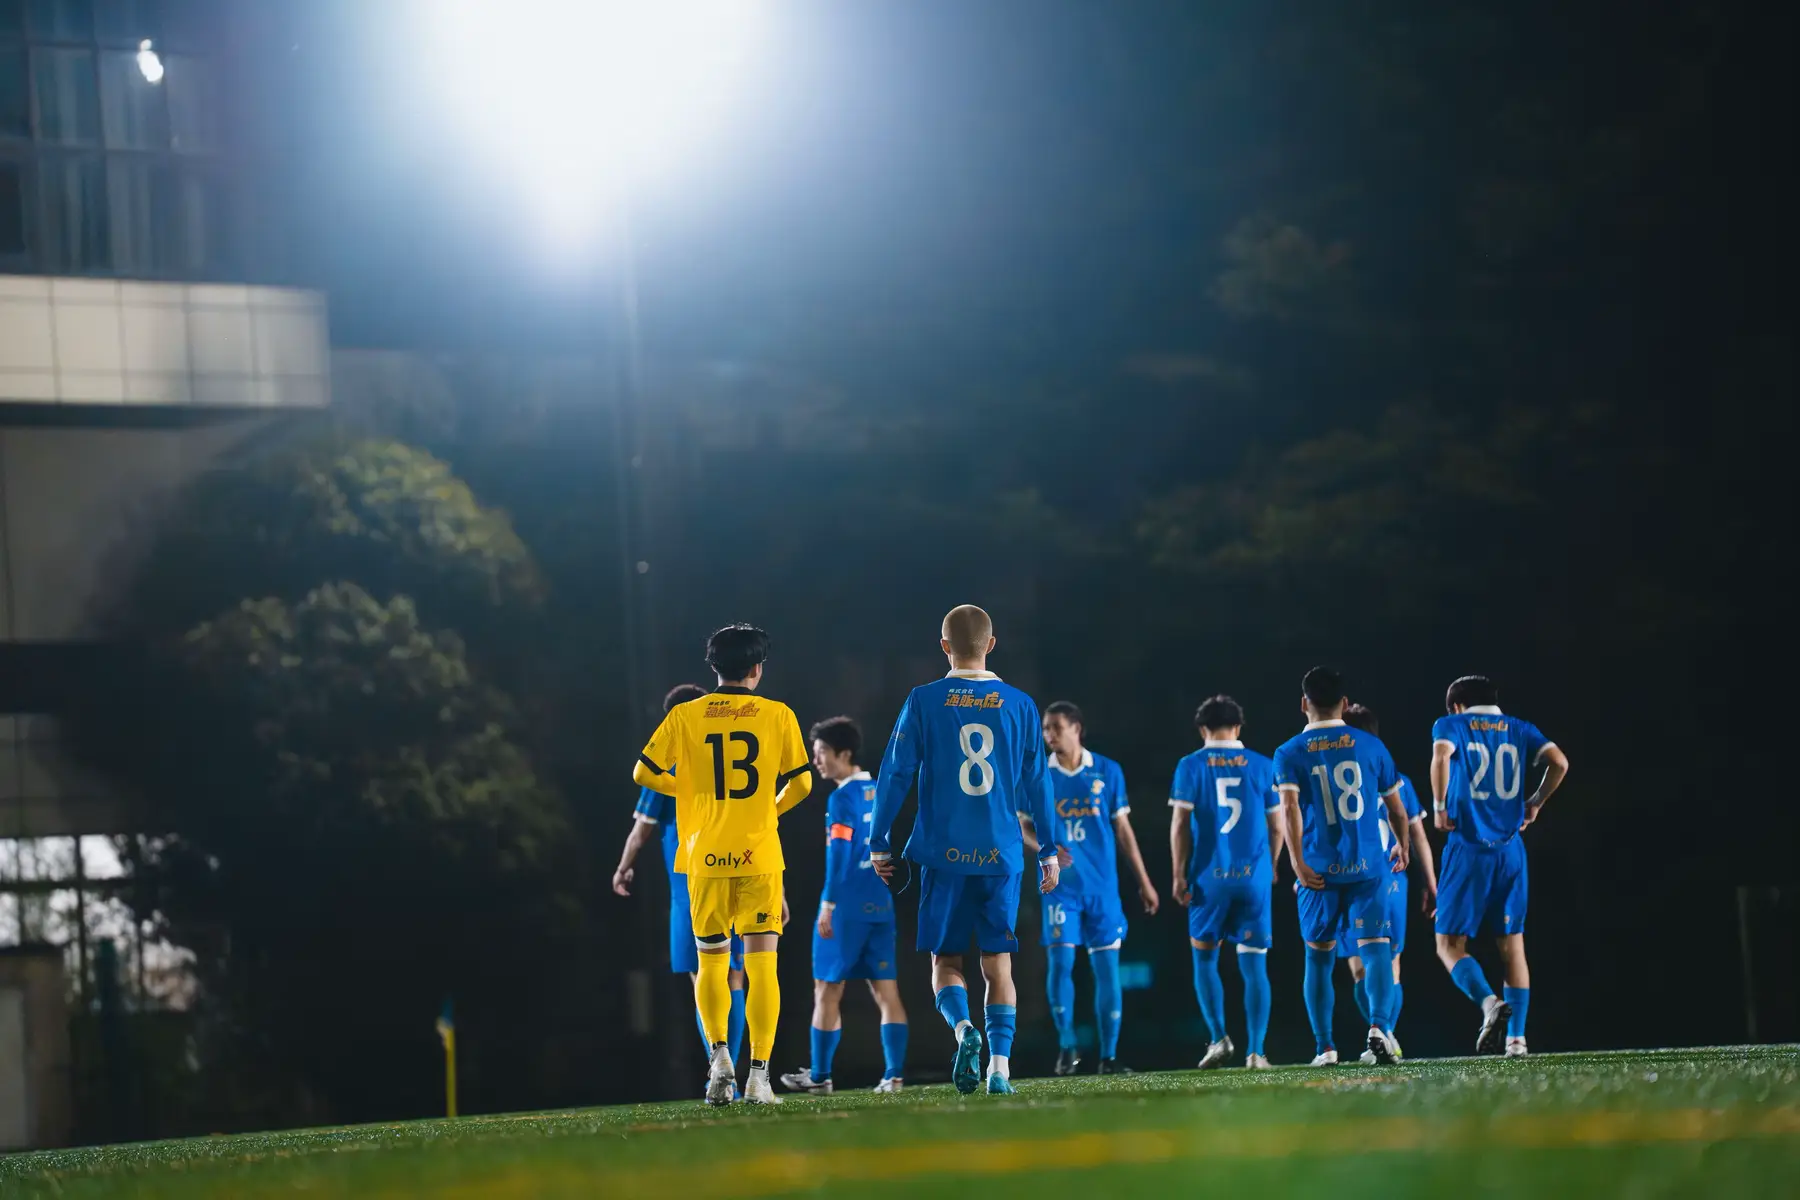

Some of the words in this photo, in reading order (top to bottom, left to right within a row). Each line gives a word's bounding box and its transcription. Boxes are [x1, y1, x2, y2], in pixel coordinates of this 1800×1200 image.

[944, 691, 1005, 712] 通販の虎
[704, 730, 760, 801] 13
[959, 723, 994, 796] 8
[1467, 741, 1520, 800] 20
[1216, 777, 1243, 834] 5
[1311, 760, 1364, 825] 18
[1065, 820, 1086, 842] 16
[704, 849, 753, 869] OnlyX
[946, 847, 1000, 867] OnlyX
[1047, 903, 1066, 926] 16
